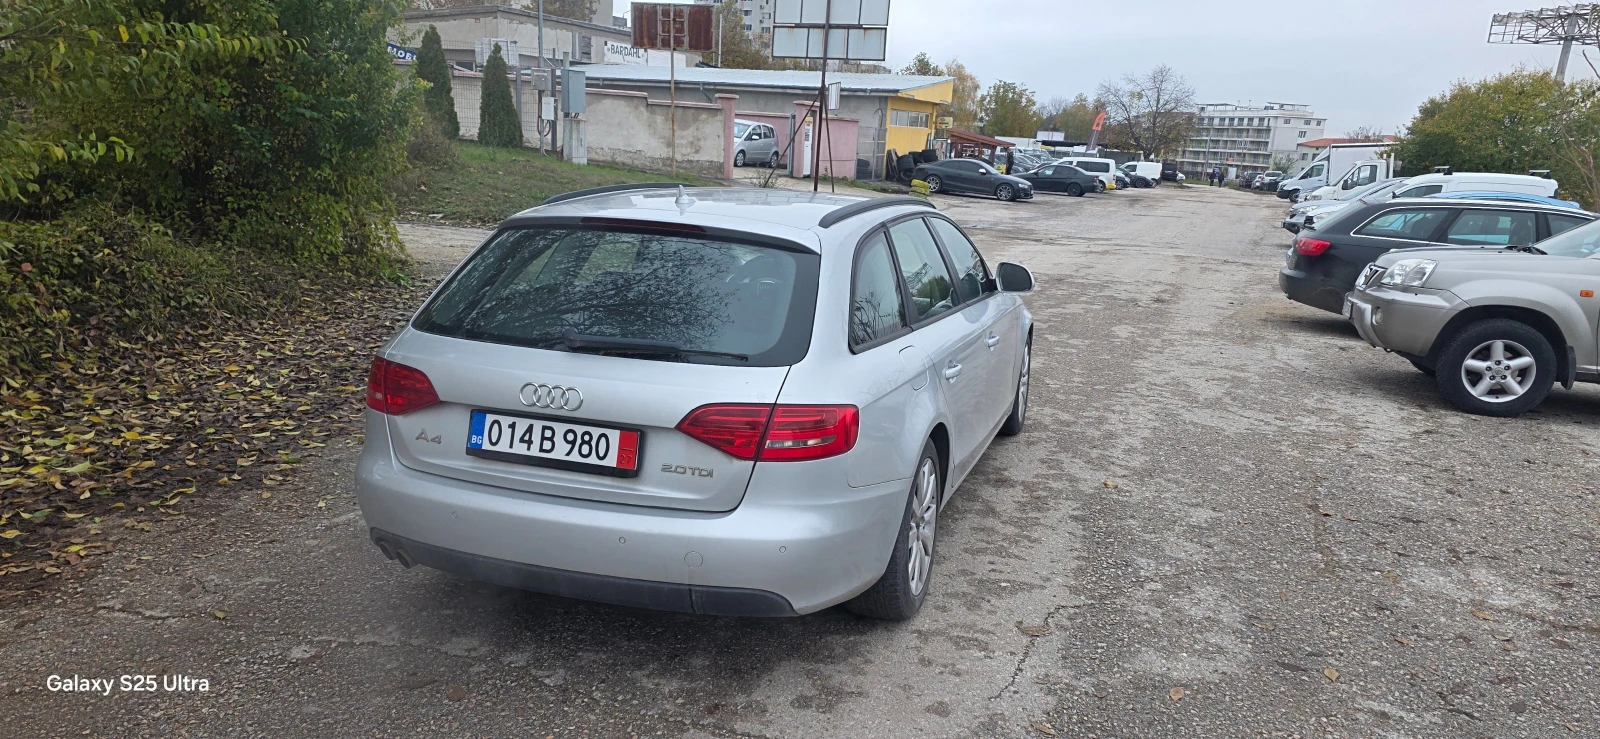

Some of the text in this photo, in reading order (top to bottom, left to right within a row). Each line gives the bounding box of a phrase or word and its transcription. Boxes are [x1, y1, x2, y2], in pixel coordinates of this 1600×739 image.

[610, 44, 641, 61] BARDAHL
[415, 427, 442, 444] A4
[471, 435, 483, 444] BG
